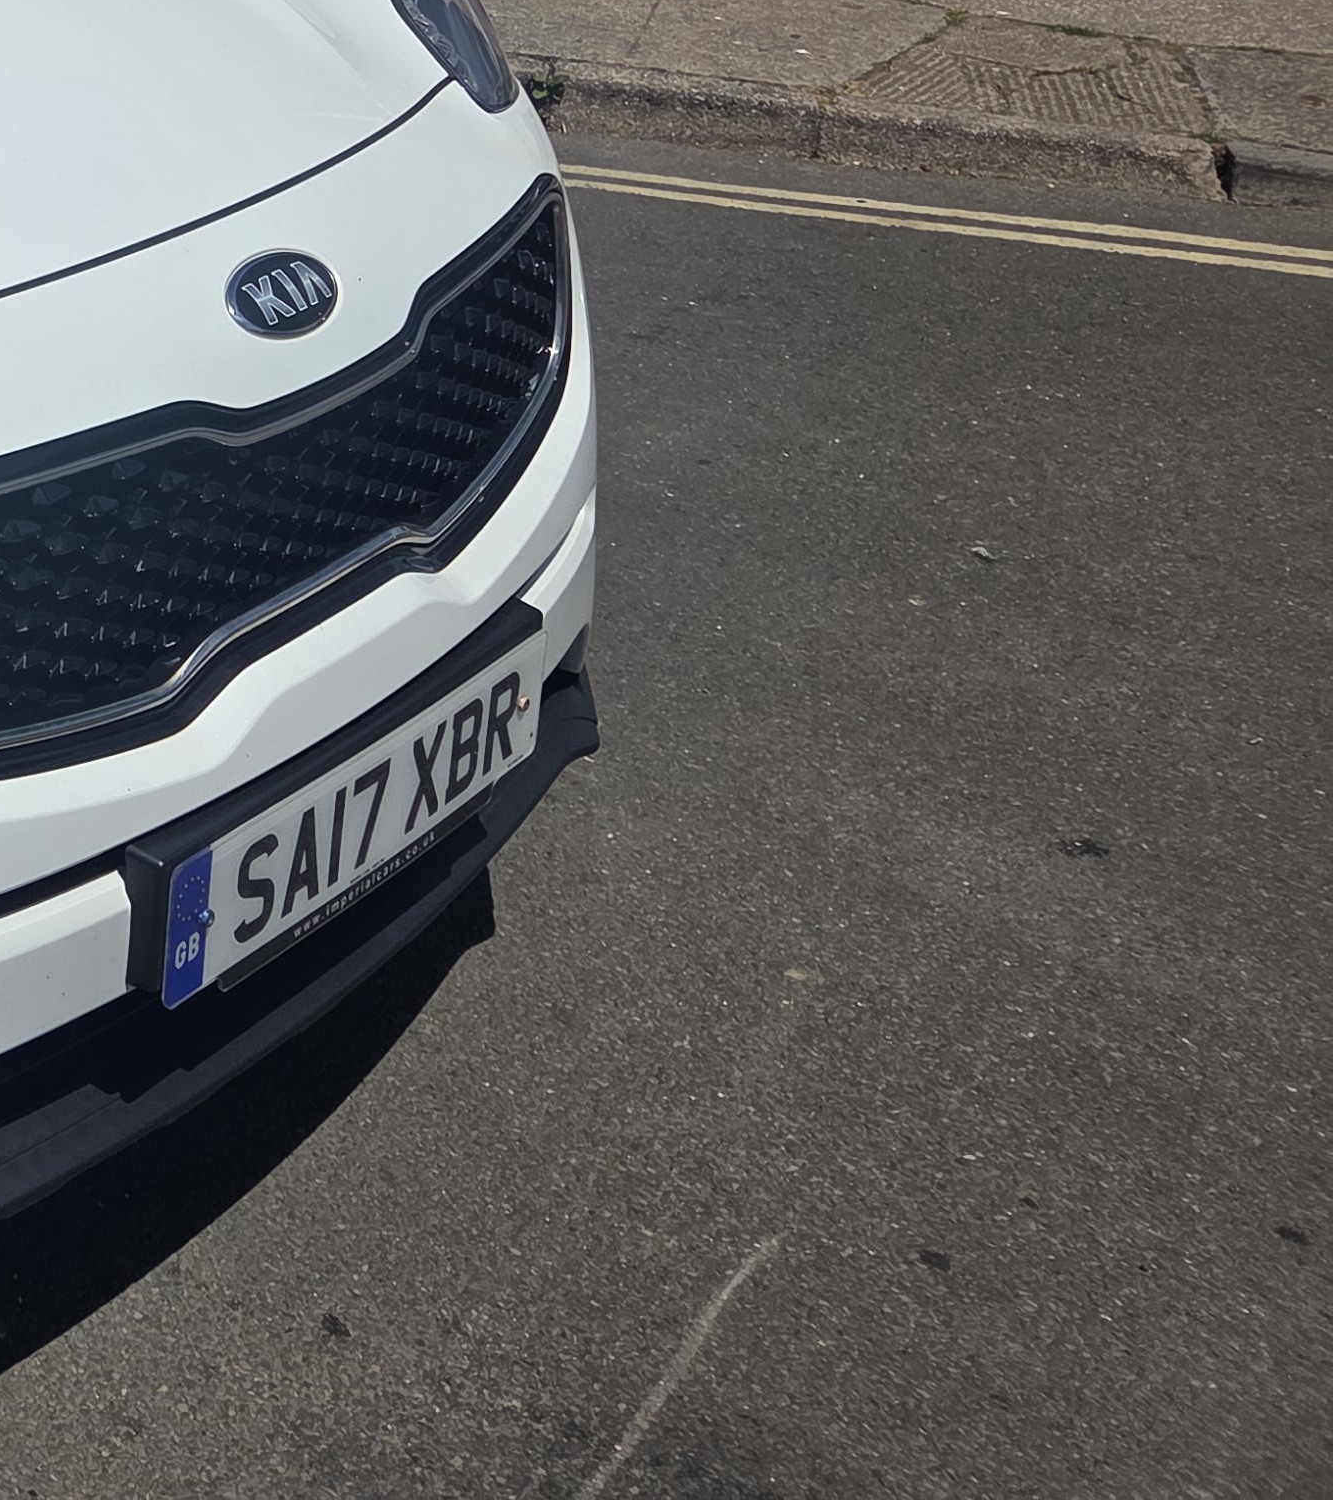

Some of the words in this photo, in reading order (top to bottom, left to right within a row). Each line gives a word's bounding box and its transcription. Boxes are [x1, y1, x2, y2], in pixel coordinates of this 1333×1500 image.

[241, 261, 332, 325] KIA
[234, 757, 391, 943] SA17
[404, 671, 521, 834] XBR
[293, 831, 436, 938] www.imperialcars.co.uk
[174, 931, 200, 969] GB
